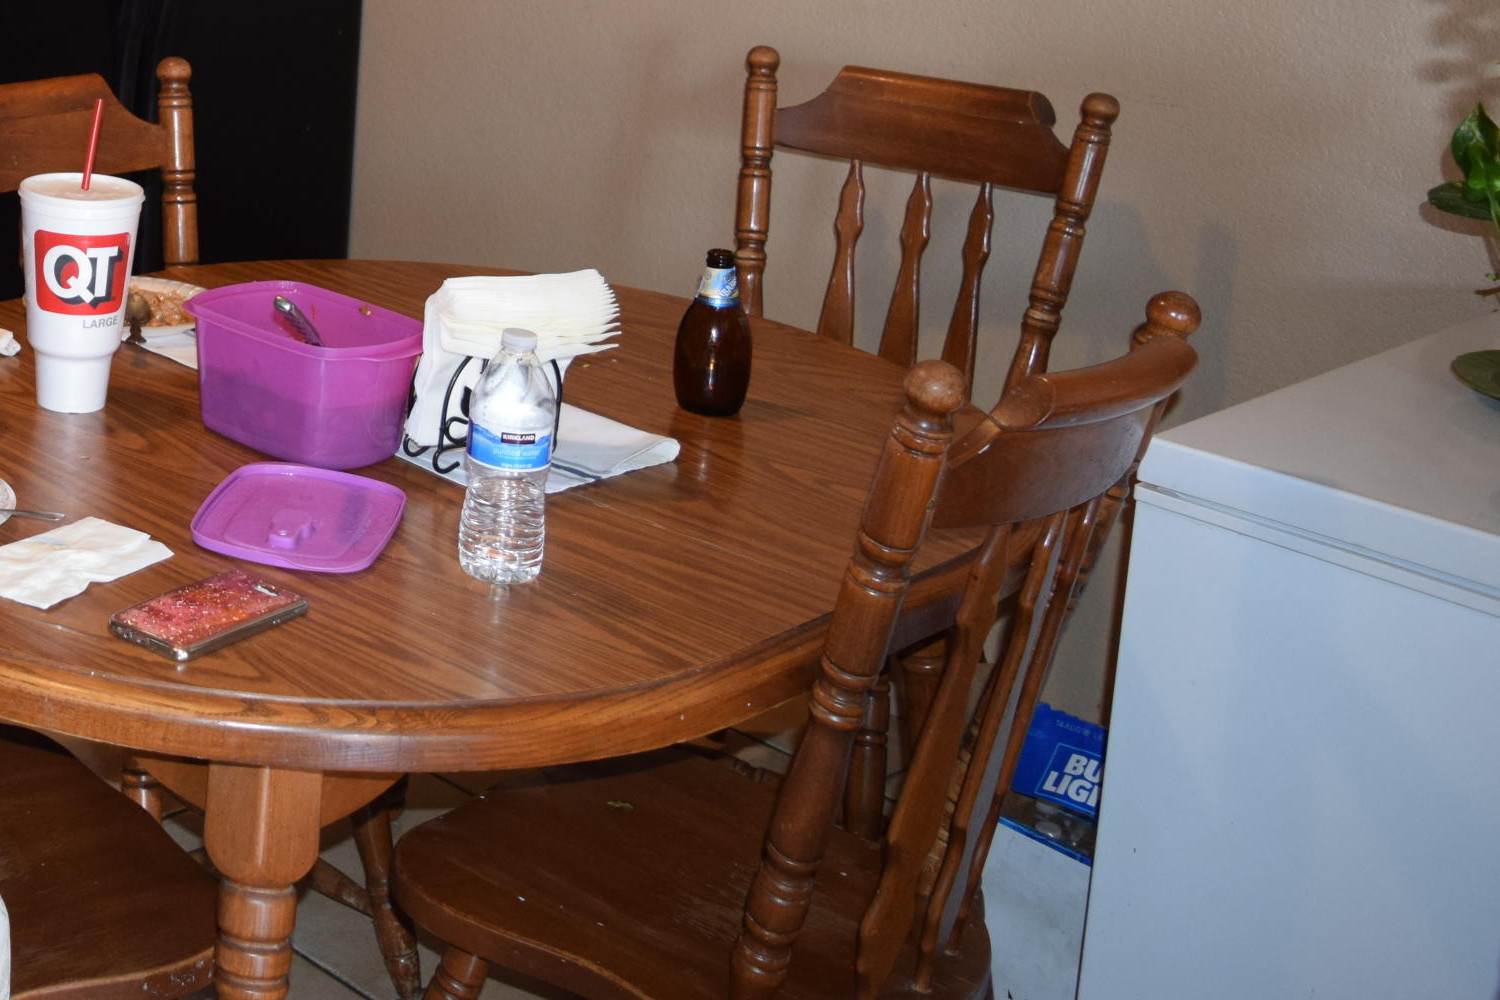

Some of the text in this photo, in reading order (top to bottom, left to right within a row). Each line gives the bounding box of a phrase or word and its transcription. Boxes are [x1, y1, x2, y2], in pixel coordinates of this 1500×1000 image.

[43, 245, 119, 304] QT
[1063, 753, 1102, 783] BU
[1042, 770, 1099, 808] LIG
